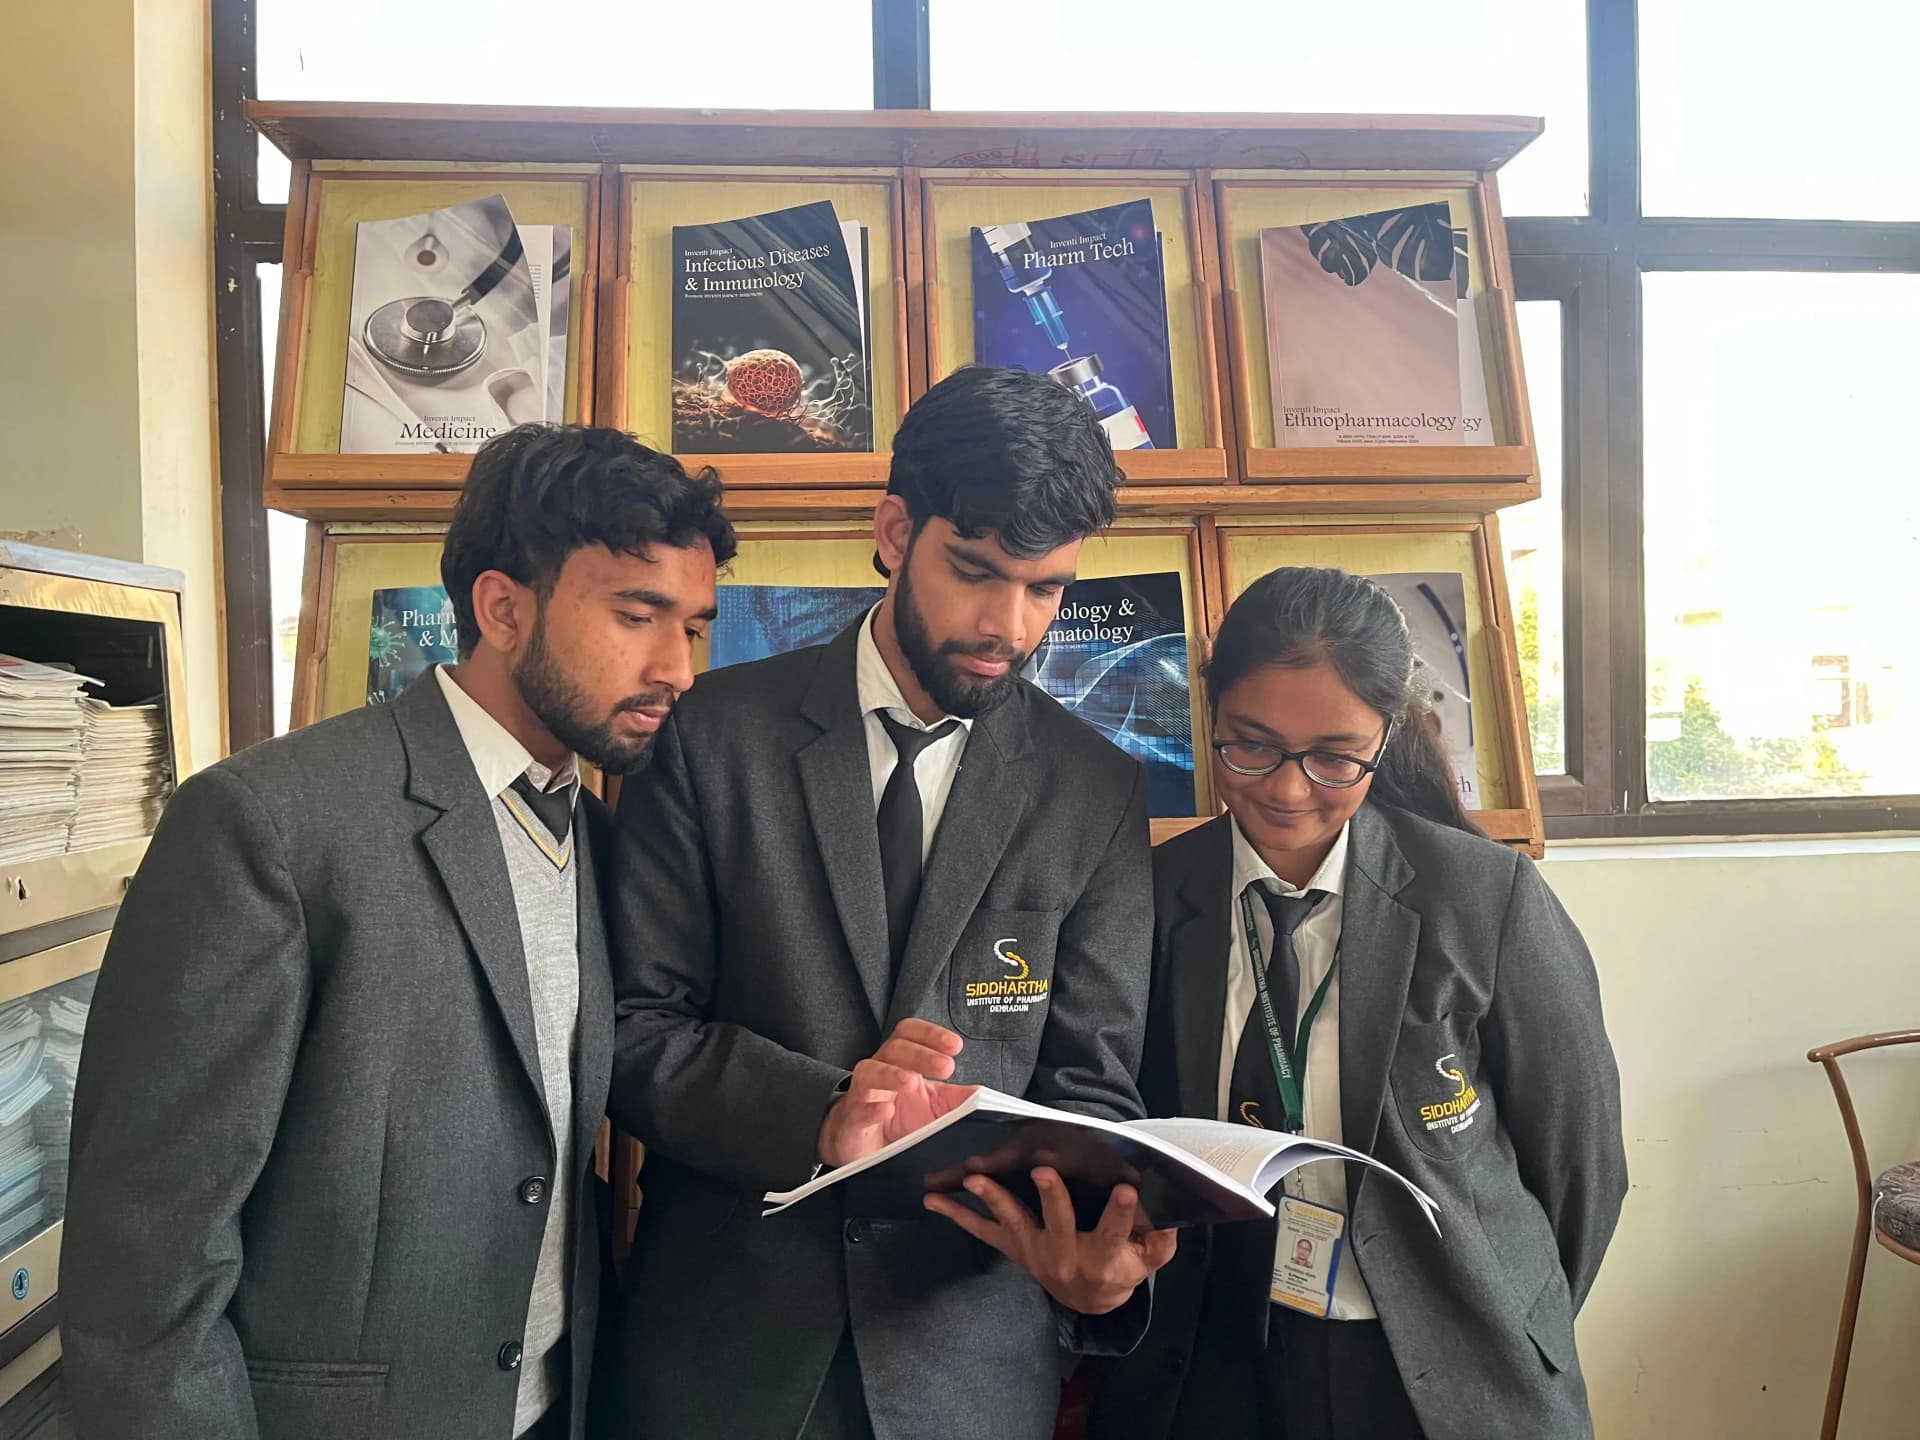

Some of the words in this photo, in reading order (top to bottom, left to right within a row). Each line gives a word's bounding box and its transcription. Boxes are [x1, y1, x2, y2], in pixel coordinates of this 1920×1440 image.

[1050, 238, 1077, 249] Inventi
[1079, 232, 1106, 244] Impact
[684, 249, 708, 257] Inventi
[709, 247, 733, 257] Impact
[685, 256, 765, 273] Infectious
[768, 244, 830, 266] Diseases
[1023, 250, 1086, 269] Pharm
[1089, 237, 1135, 261] Tech
[684, 277, 698, 291] &
[703, 271, 805, 291] Immunology
[1283, 405, 1311, 413] Inventi
[1312, 405, 1341, 415] Impact
[450, 415, 476, 423] Impact
[1284, 413, 1457, 431] Ethnopharmacology
[1462, 416, 1482, 432] gy
[400, 422, 497, 439] Medicine
[1118, 598, 1136, 616] &
[419, 630, 434, 647] &
[965, 978, 1048, 997] SIDDHARTHA
[966, 996, 1001, 1007] INSTITUTE
[1003, 996, 1014, 1004] OF
[1260, 990, 1278, 1028] INSTITUTE
[1269, 1026, 1281, 1037] OF
[1271, 1037, 1292, 1079] PHARMACY
